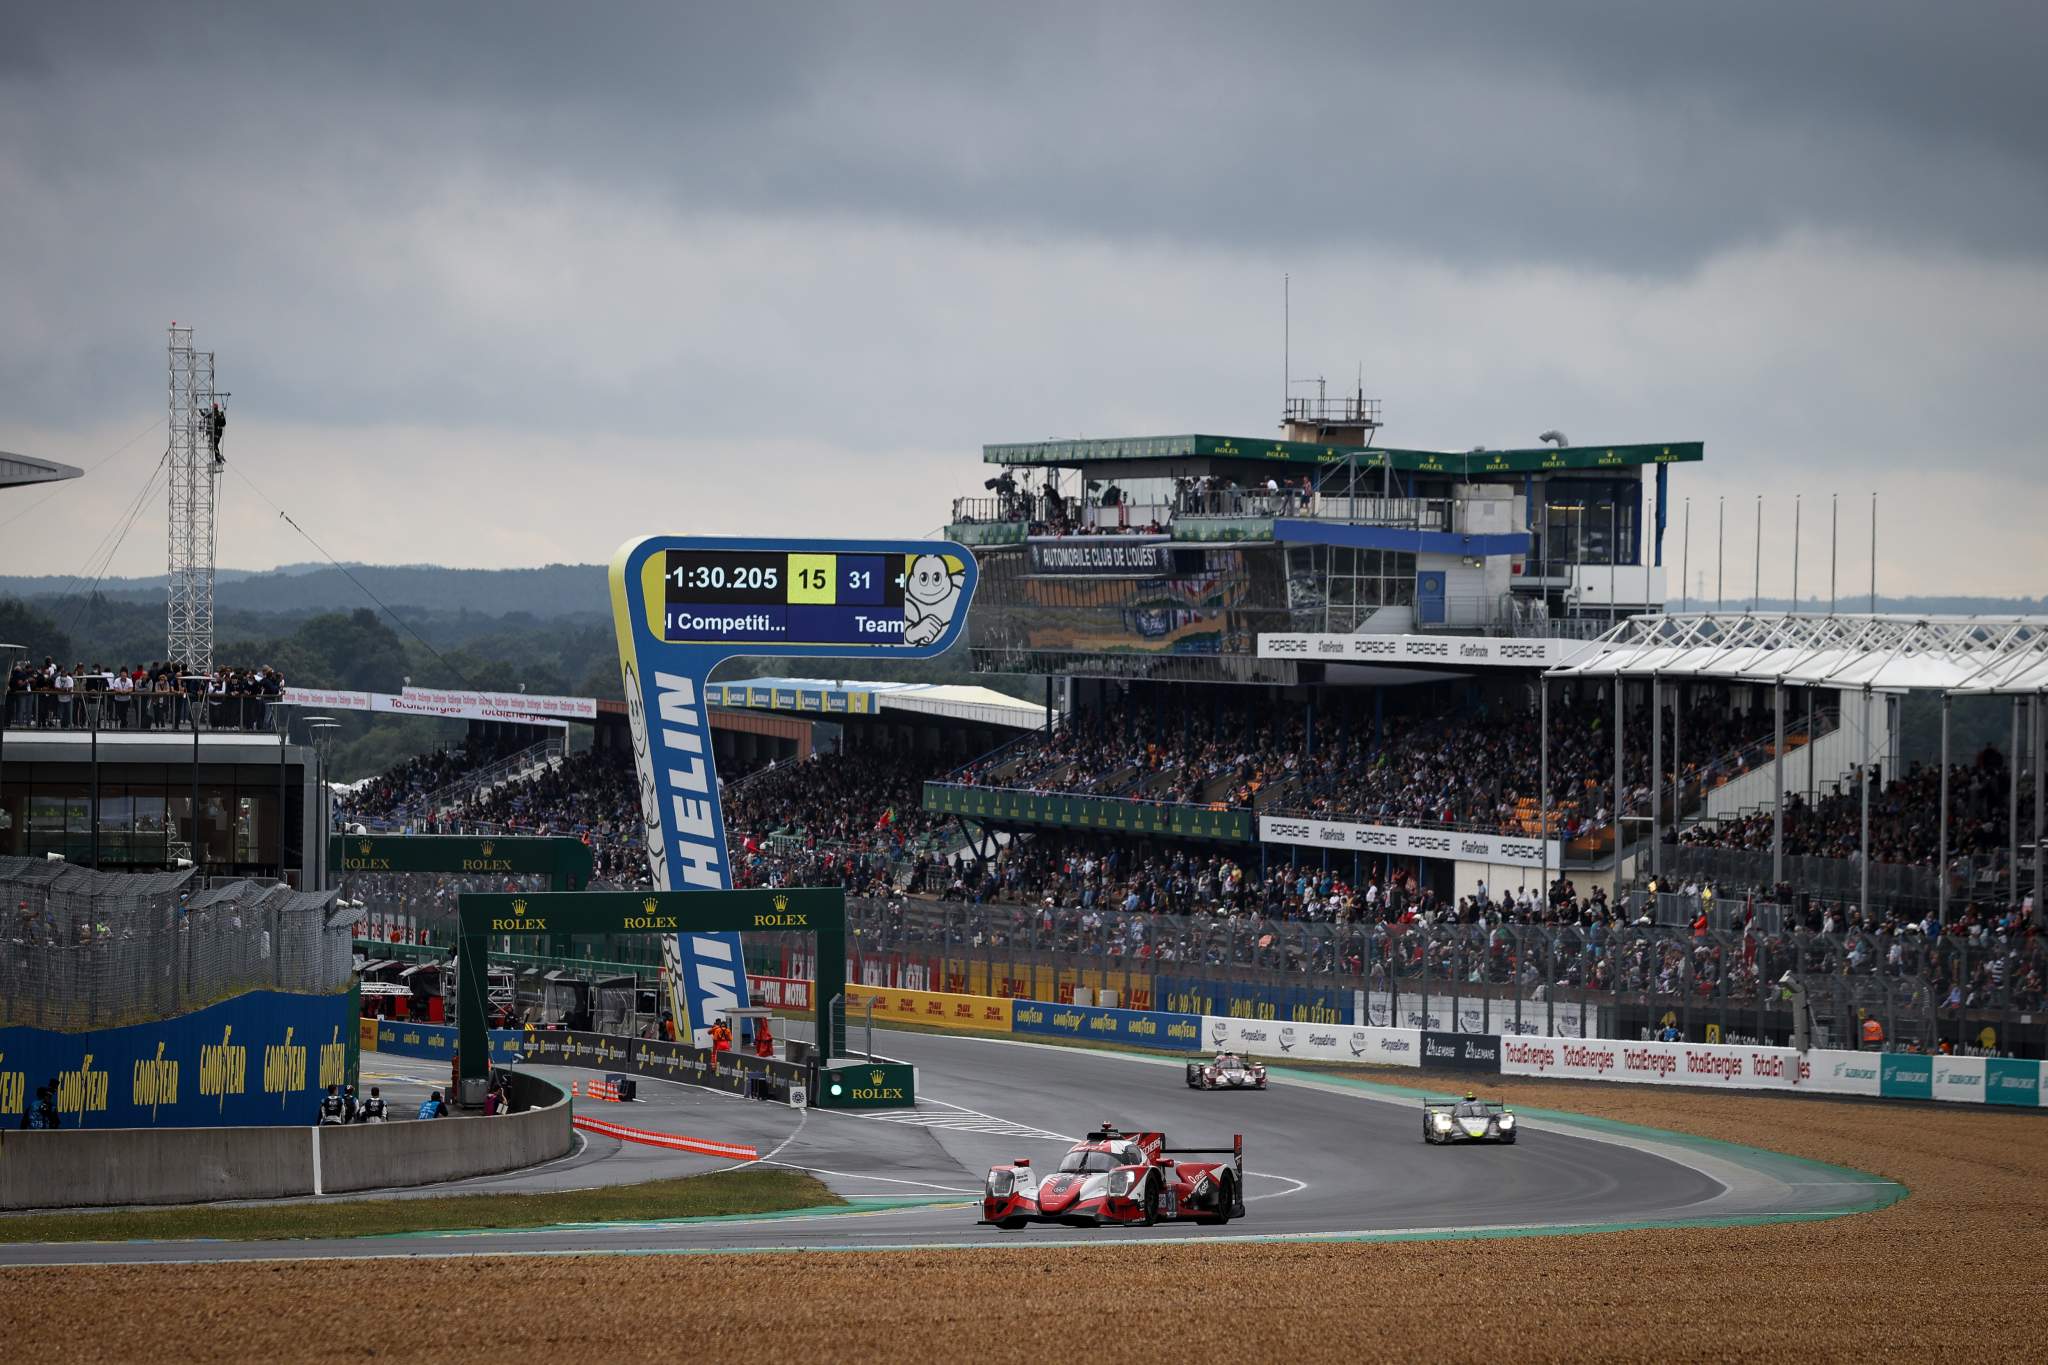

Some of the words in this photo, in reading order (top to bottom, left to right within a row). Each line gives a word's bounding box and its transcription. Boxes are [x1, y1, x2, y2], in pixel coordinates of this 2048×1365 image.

[1542, 460, 1566, 468] ROLEX
[1654, 454, 1678, 462] ROLEX
[1043, 548, 1090, 567] AUTOMOBILE
[1092, 548, 1111, 566] CLUB
[1112, 548, 1124, 566] DE
[1125, 548, 1156, 566] L'OUEST
[798, 568, 826, 590] 15
[849, 571, 871, 589] 31
[678, 613, 786, 634] Competiti...
[855, 616, 904, 633] Team
[1268, 640, 1308, 652] PORSCHE
[1354, 641, 1396, 654] PORSCHE
[1406, 642, 1448, 656] PORSCHE
[1500, 645, 1546, 658] PORSCHE
[1270, 823, 1310, 838] PORSCHE
[1356, 830, 1397, 846] PORSCHE
[1408, 835, 1450, 851] PORSCHE
[654, 671, 738, 1027] MIHELIN
[342, 858, 390, 870] ROLEX
[463, 859, 512, 870] ROLEX
[492, 918, 546, 930] ROLEX
[624, 916, 678, 928] ROLEX
[754, 914, 808, 926] ROLEX
[785, 983, 807, 1007] MOTUL
[1505, 1042, 1554, 1070] TotalEnergies
[1564, 1044, 1614, 1074] TotalEnergies
[1624, 1045, 1676, 1077] TotalEnergies
[1686, 1048, 1742, 1080] TotalEnergies
[200, 1044, 246, 1096] GOODYEAR
[264, 1044, 307, 1093] GOODYEAR
[1752, 1052, 1811, 1084] TotalEnies
[57, 1071, 108, 1113] GOODYEAR
[133, 1058, 178, 1106] GOODYEAR
[852, 1088, 904, 1100] ROLEX
